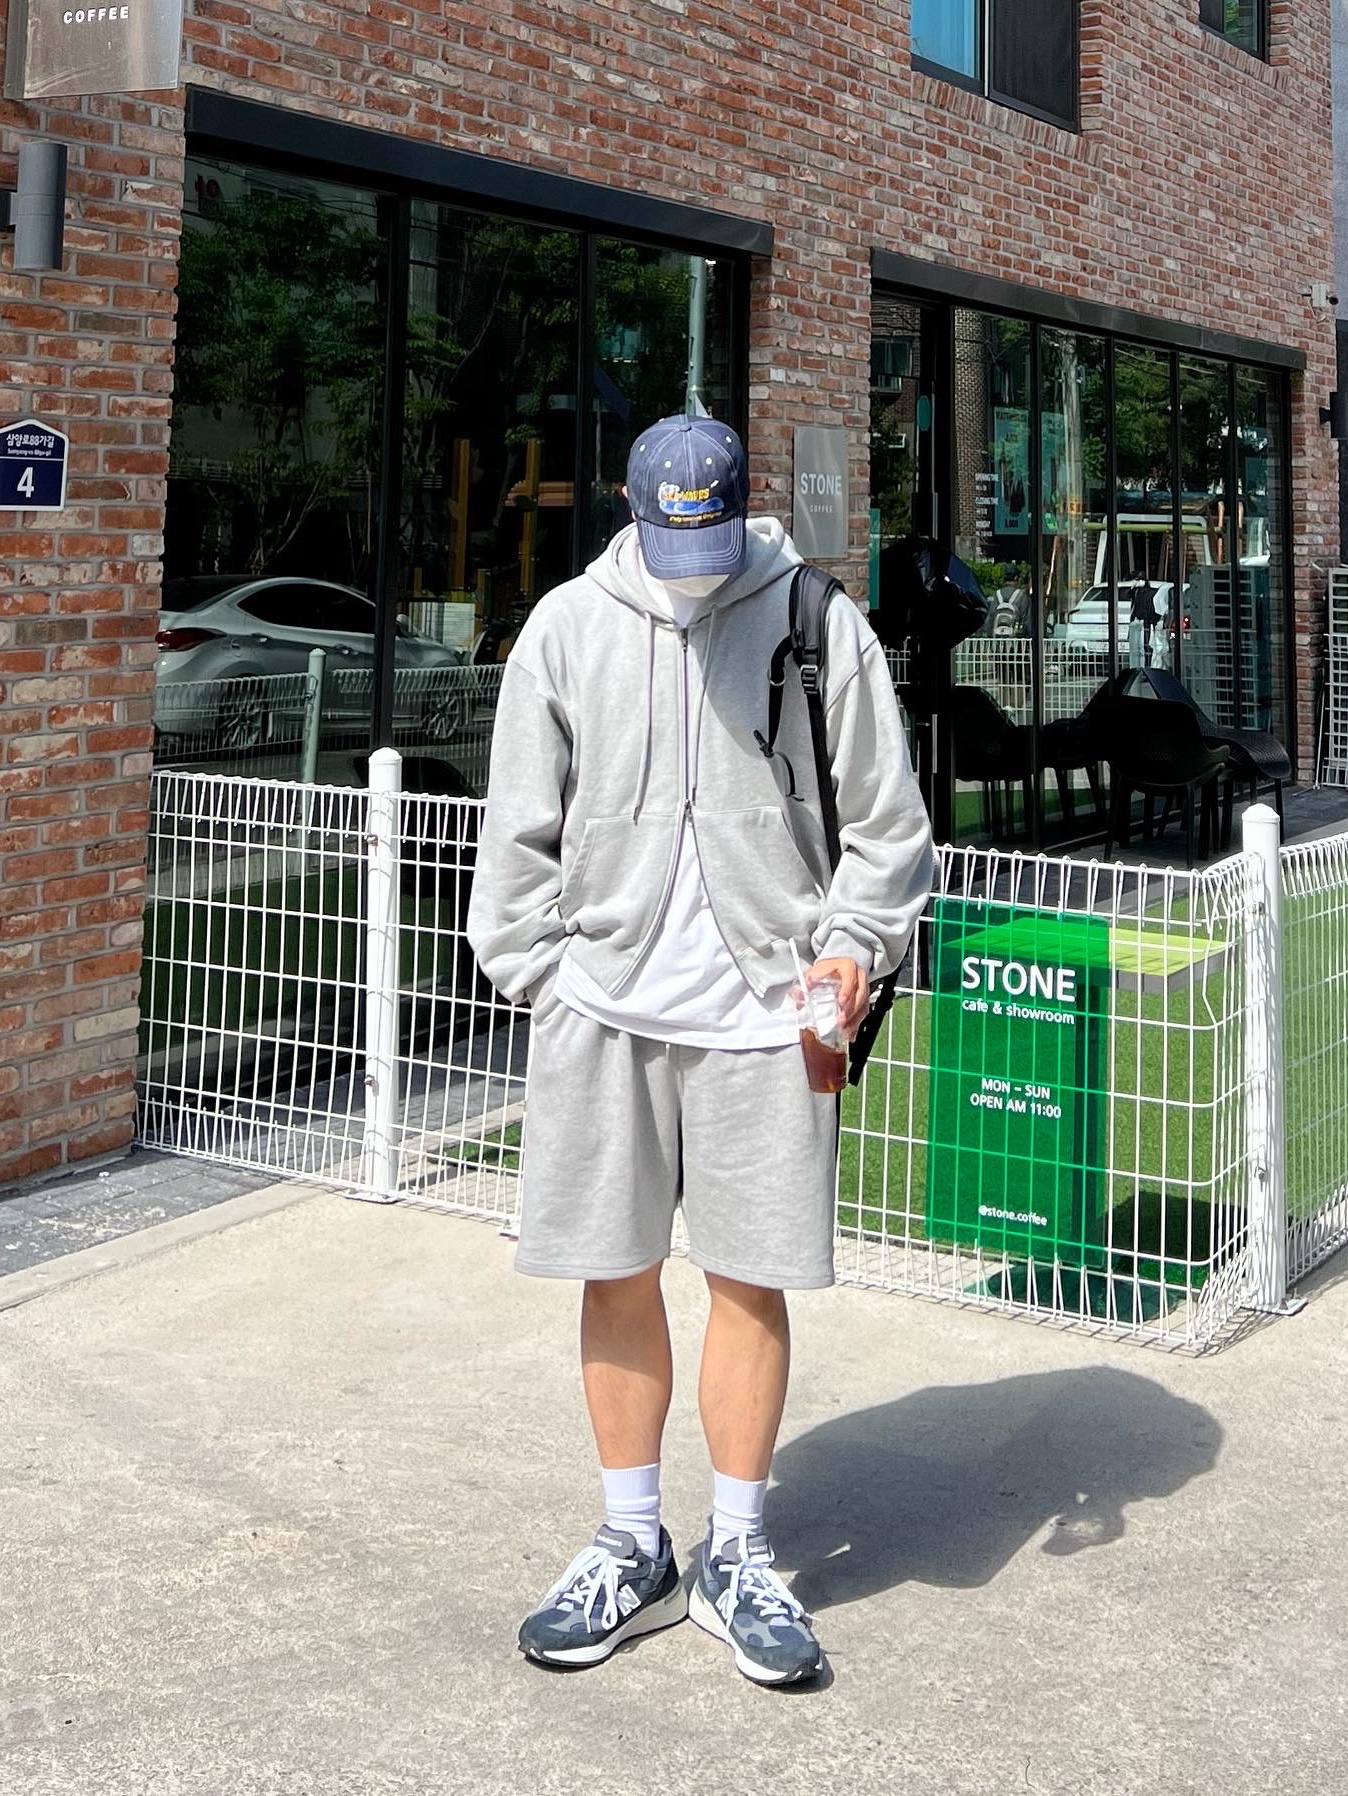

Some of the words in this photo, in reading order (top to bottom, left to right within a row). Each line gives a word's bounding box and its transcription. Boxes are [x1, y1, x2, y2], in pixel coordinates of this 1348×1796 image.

[63, 6, 129, 24] COFFEE
[16, 466, 35, 498] 4
[800, 472, 842, 495] STONE
[810, 504, 833, 513] COFFEE
[961, 956, 1076, 1003] STONE
[962, 998, 988, 1013] cafe
[992, 1001, 1002, 1015] &
[1006, 1003, 1075, 1025] showroom
[982, 1078, 1011, 1094] MON
[1024, 1084, 1050, 1100] SUN
[970, 1093, 1003, 1110] OPEN
[1006, 1098, 1026, 1113] AM
[1030, 1102, 1062, 1119] 11:00
[978, 1205, 1048, 1226] @stone.coffee
